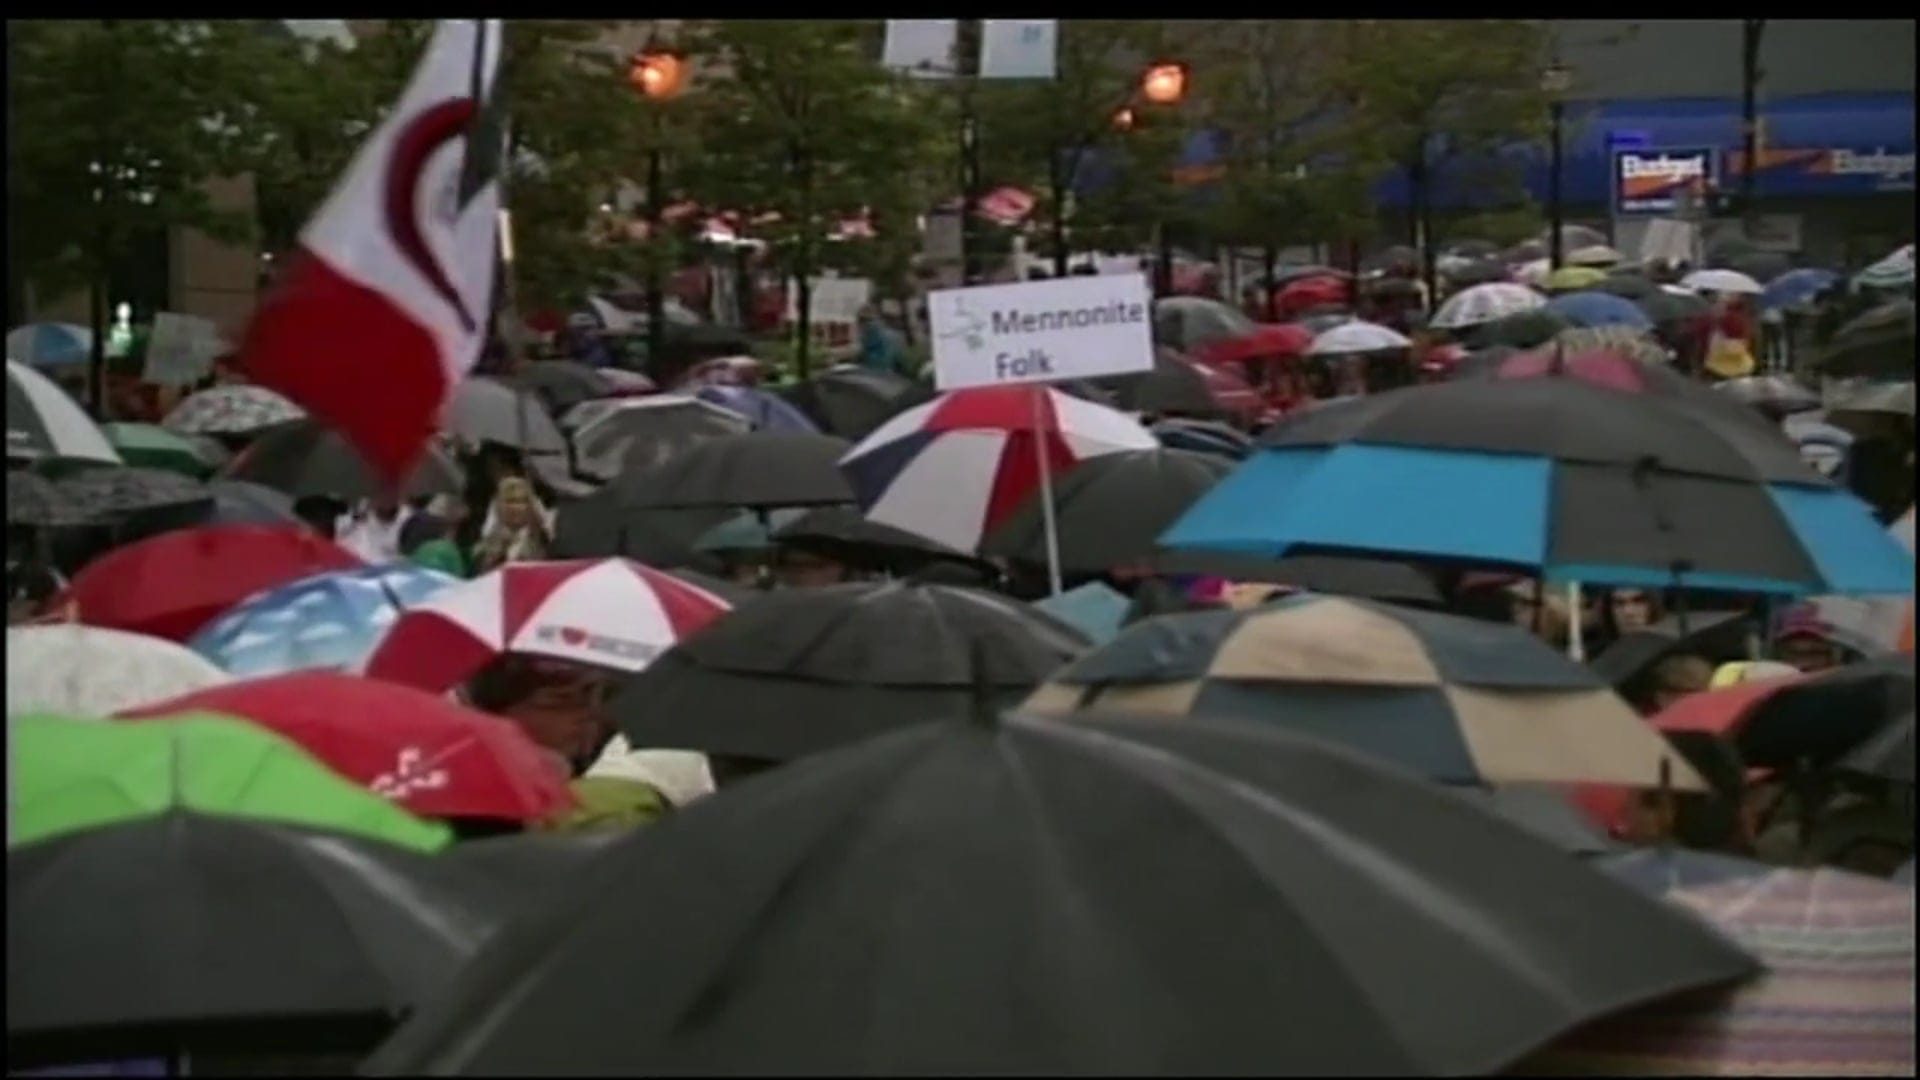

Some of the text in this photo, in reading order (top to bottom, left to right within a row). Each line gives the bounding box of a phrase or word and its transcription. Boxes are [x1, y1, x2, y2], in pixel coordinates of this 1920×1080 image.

[1621, 153, 1704, 182] Budget
[991, 300, 1144, 334] Mennonite
[995, 349, 1055, 378] Folk
